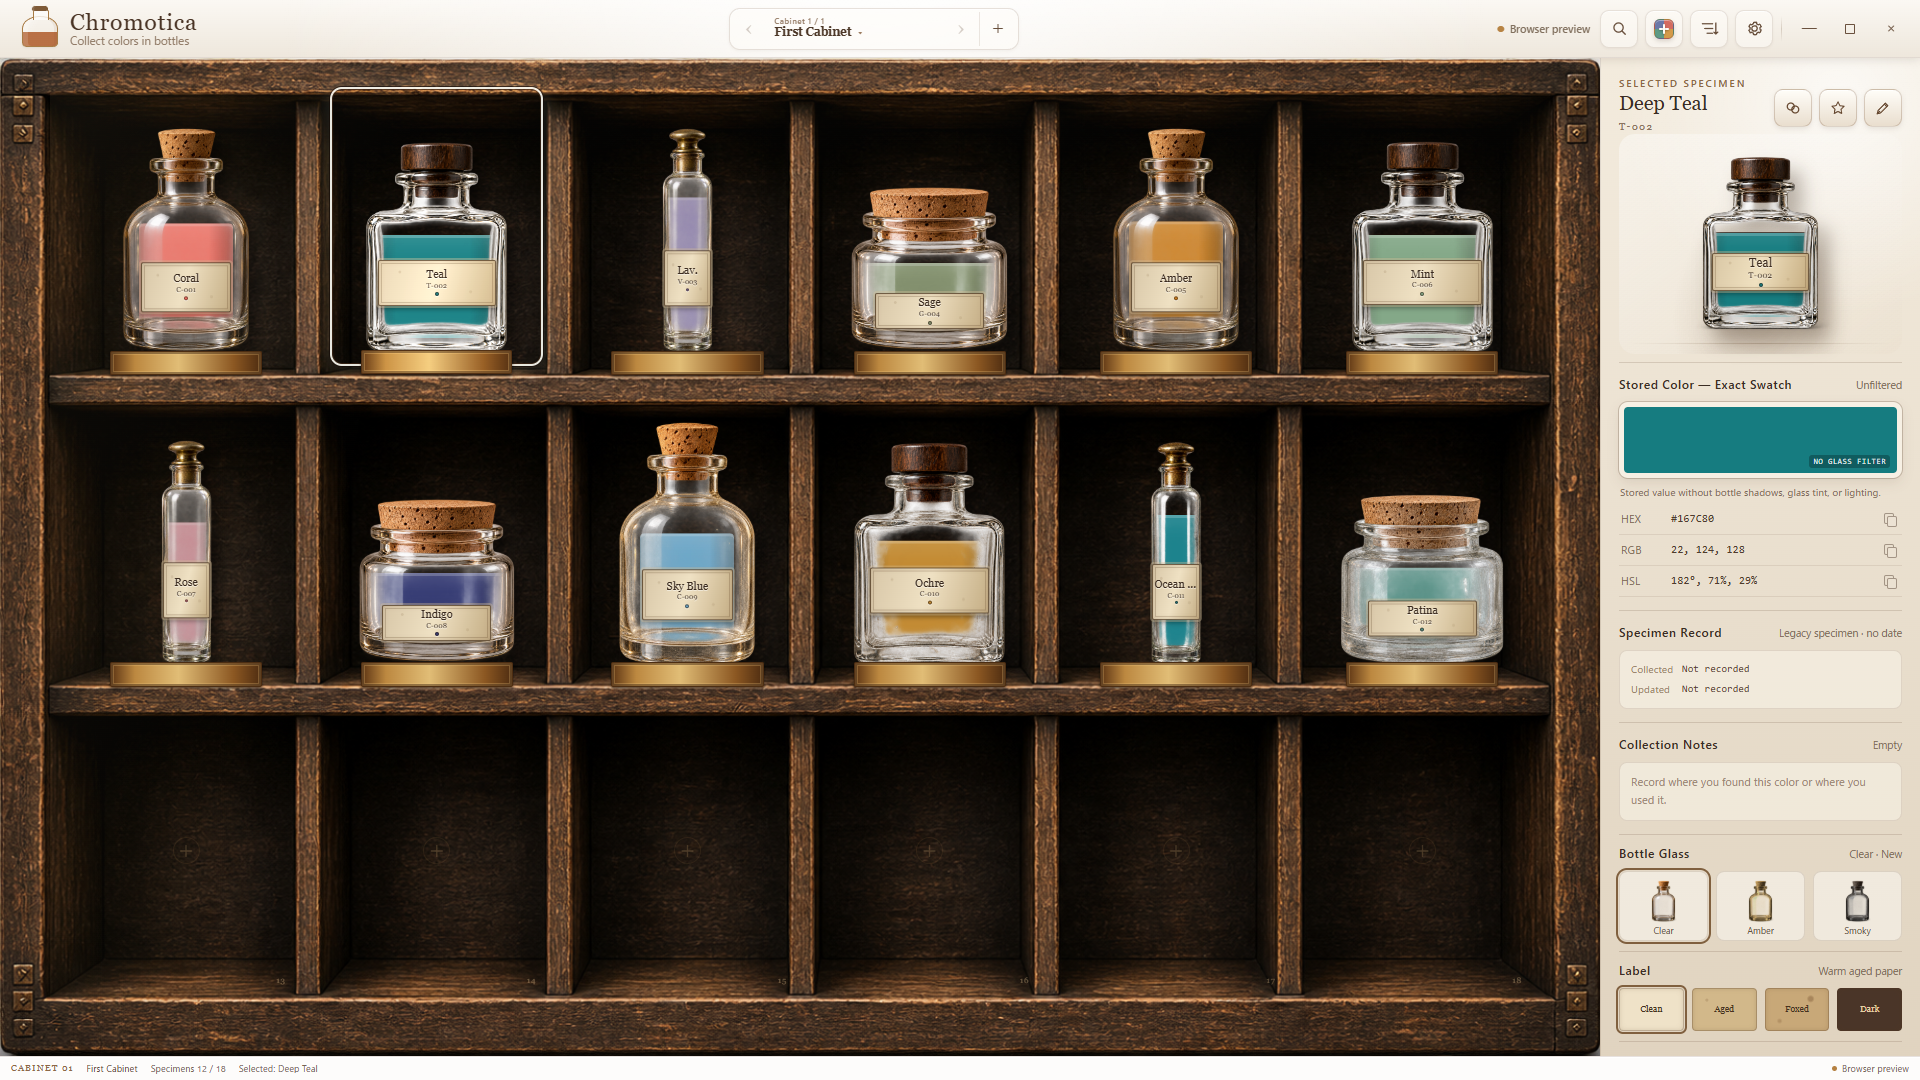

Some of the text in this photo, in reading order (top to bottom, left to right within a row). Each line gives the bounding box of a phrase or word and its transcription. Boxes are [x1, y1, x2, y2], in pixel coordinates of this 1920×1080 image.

[71, 13, 196, 30] Chromotica
[773, 17, 825, 26] Cabinet 1 / 1
[773, 25, 853, 37] First Cabinet
[1510, 24, 1591, 36] Browser preview
[69, 35, 190, 46] Collect colors in bottles
[1618, 79, 1745, 88] SELECTED SPECIMEN
[1620, 95, 1707, 114] Deep Teal
[1618, 122, 1653, 131] T-002
[1748, 256, 1773, 268] Teal
[425, 268, 448, 279] Teal
[677, 265, 698, 275] Lav.
[1410, 269, 1435, 279] Mint
[1747, 271, 1773, 279] T-002
[173, 272, 200, 283] Coral
[677, 278, 698, 286] V-003
[1159, 272, 1193, 283] Amber
[1165, 286, 1187, 294] C-005
[918, 297, 942, 309] Sage
[918, 310, 941, 318] G-004
[1618, 379, 1658, 390] Stored
[1662, 379, 1695, 390] Color
[1715, 379, 1747, 390] Exact
[1749, 379, 1792, 390] Swatch
[1856, 380, 1903, 390] Unfiltered
[1813, 457, 1887, 465] NO GLASS FILTER
[1619, 488, 1650, 497] Stored
[1651, 488, 1676, 497] value
[1677, 488, 1713, 497] without
[1715, 488, 1742, 497] bottle
[1743, 488, 1785, 498] shadows,
[1787, 488, 1810, 499] glass
[1811, 488, 1830, 498] tint,
[1844, 488, 1881, 499] lighting.
[1621, 514, 1642, 524] HEX
[1670, 514, 1715, 523] #167C80
[1621, 545, 1642, 555] RGB
[1671, 545, 1745, 556] 22, 124, 128
[174, 577, 199, 587] Rose
[667, 580, 709, 592] Sky Blue
[914, 577, 945, 588] Ochre
[1154, 579, 1186, 589] Ocean
[1621, 576, 1641, 586] HSL
[1707, 575, 1732, 587] 71%,
[1738, 575, 1758, 585] 29%
[176, 590, 197, 598] C-007
[676, 593, 698, 601] C-009
[421, 609, 452, 620] Indigo
[1406, 605, 1439, 615] Patina
[1619, 627, 1722, 640] Specimen Record
[1779, 628, 1812, 640] Legacy
[1813, 628, 1859, 640] specimen
[1866, 630, 1880, 638] no
[1881, 628, 1903, 638] date
[1630, 665, 1674, 674] Collected
[1681, 664, 1750, 673] Not recorded
[1630, 685, 1670, 696] Updated
[1681, 684, 1750, 693] Not recorded
[1618, 739, 1718, 750] Collection Notes
[1873, 740, 1903, 752] Empty
[1631, 777, 1866, 789] Record where you found this color or where you
[1631, 795, 1667, 805] used it.
[1619, 848, 1690, 859] Bottle Glass
[1849, 849, 1874, 860] Clear
[1881, 849, 1903, 859] New
[1653, 926, 1675, 935] Clear
[1746, 926, 1775, 935] Amber
[1844, 926, 1872, 937] Smoky
[1619, 965, 1651, 976] Label
[1817, 966, 1903, 978] Warm aged paper
[1639, 1004, 1664, 1013] Clean
[1713, 1004, 1735, 1015] Aged
[1784, 1004, 1810, 1013] Foxed
[1859, 1004, 1881, 1013] Dark
[10, 1064, 59, 1072] CABINET
[86, 1064, 138, 1073] First Cabinet
[150, 1064, 227, 1075] Specimens 12 / 18
[238, 1064, 318, 1074] Selected: Deep Teal
[1841, 1064, 1910, 1075] Browser preview
